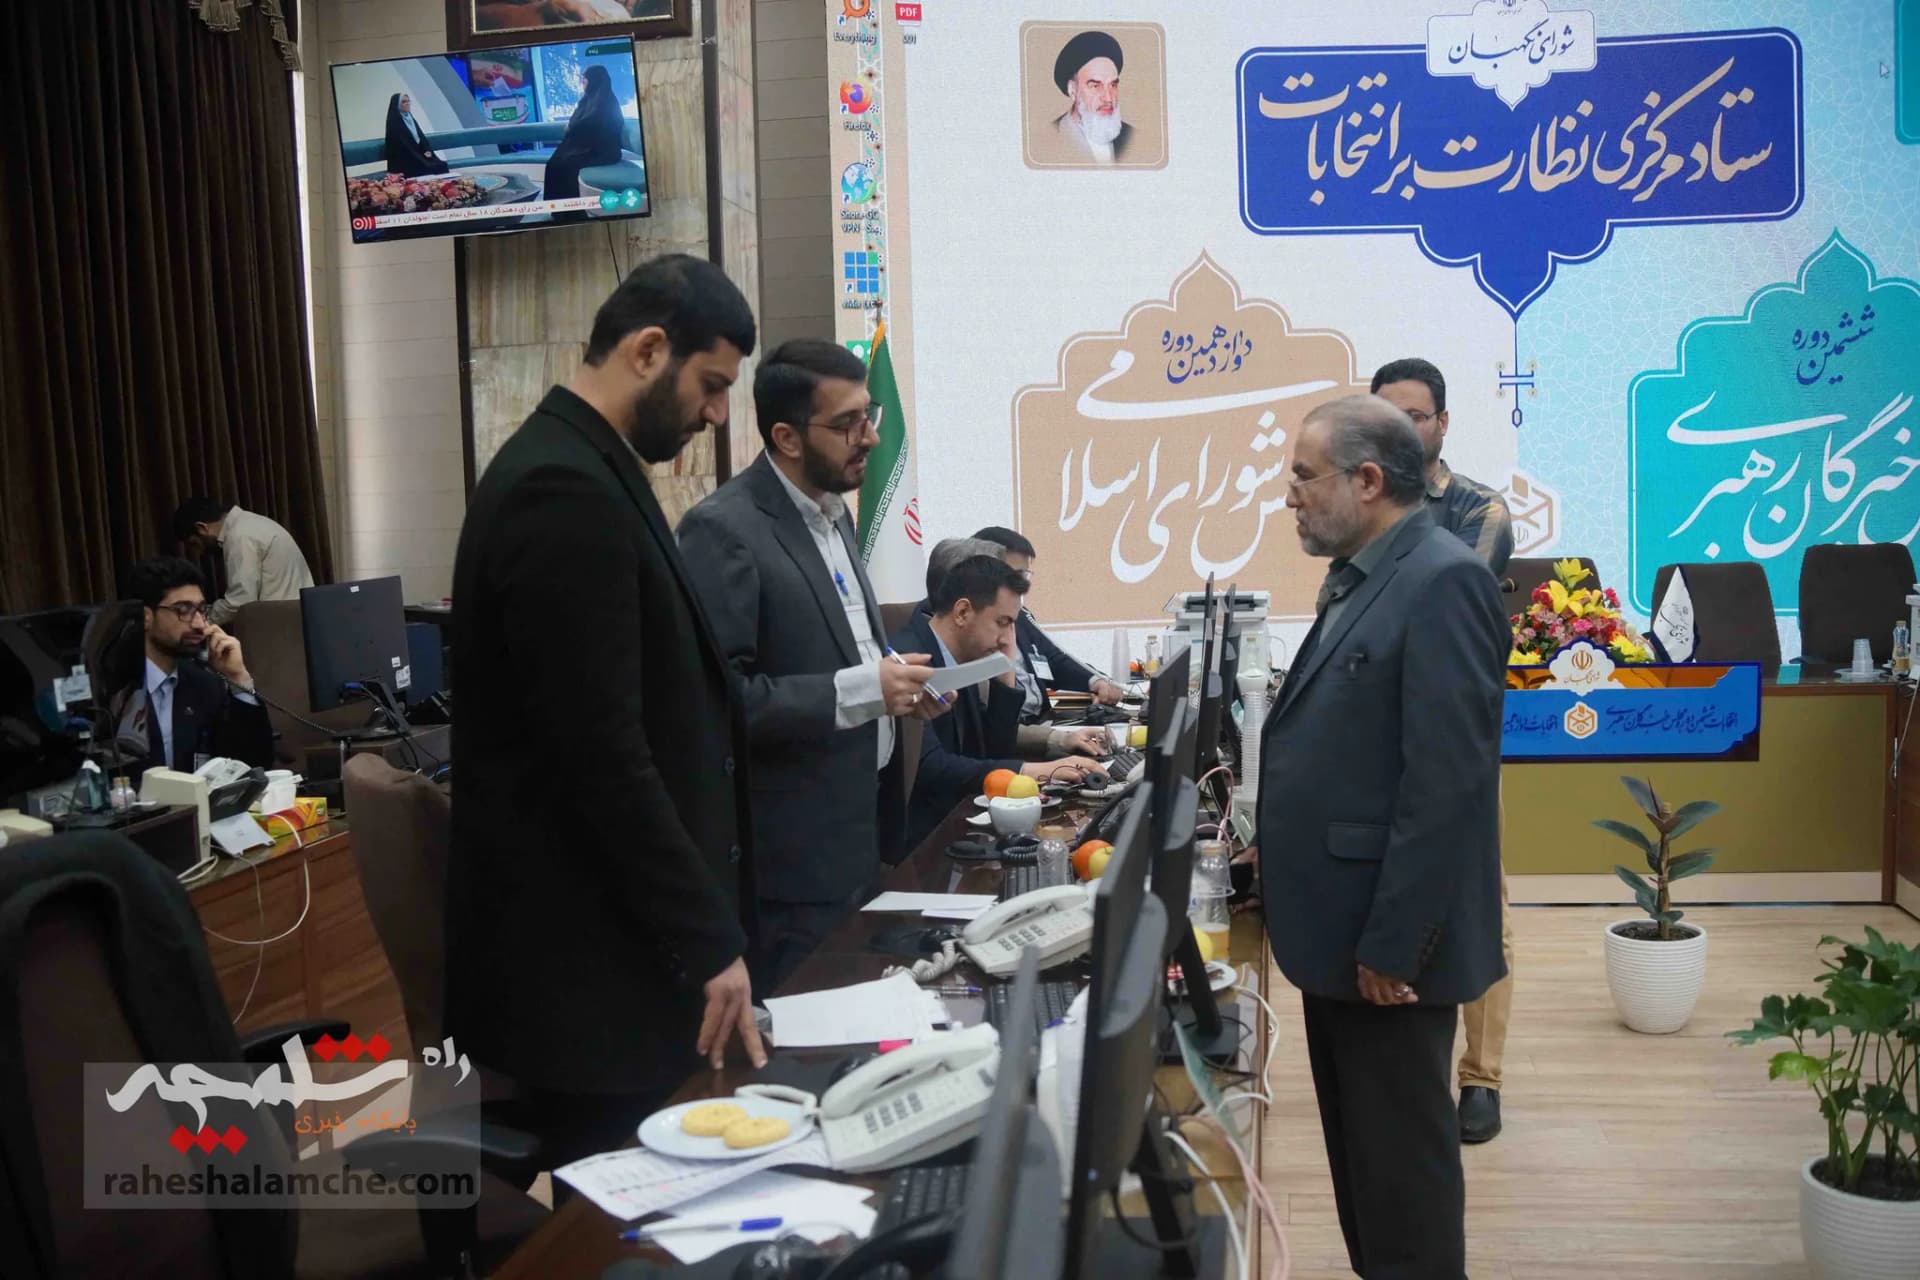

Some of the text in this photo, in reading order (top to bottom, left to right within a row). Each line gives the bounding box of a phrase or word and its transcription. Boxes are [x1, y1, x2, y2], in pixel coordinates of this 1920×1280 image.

[899, 7, 918, 17] PDF
[1448, 18, 1575, 69] شورای نگهبان
[1258, 71, 1402, 206] انتخابات
[1413, 100, 1594, 194] نظارت
[1594, 56, 1735, 203] مرکزی
[1686, 87, 1773, 184] ستاد
[1162, 329, 1194, 353] دوره
[1792, 304, 1875, 385] ششمین دوره
[1110, 410, 1287, 583] شورای
[1667, 390, 1848, 559] رهبری
